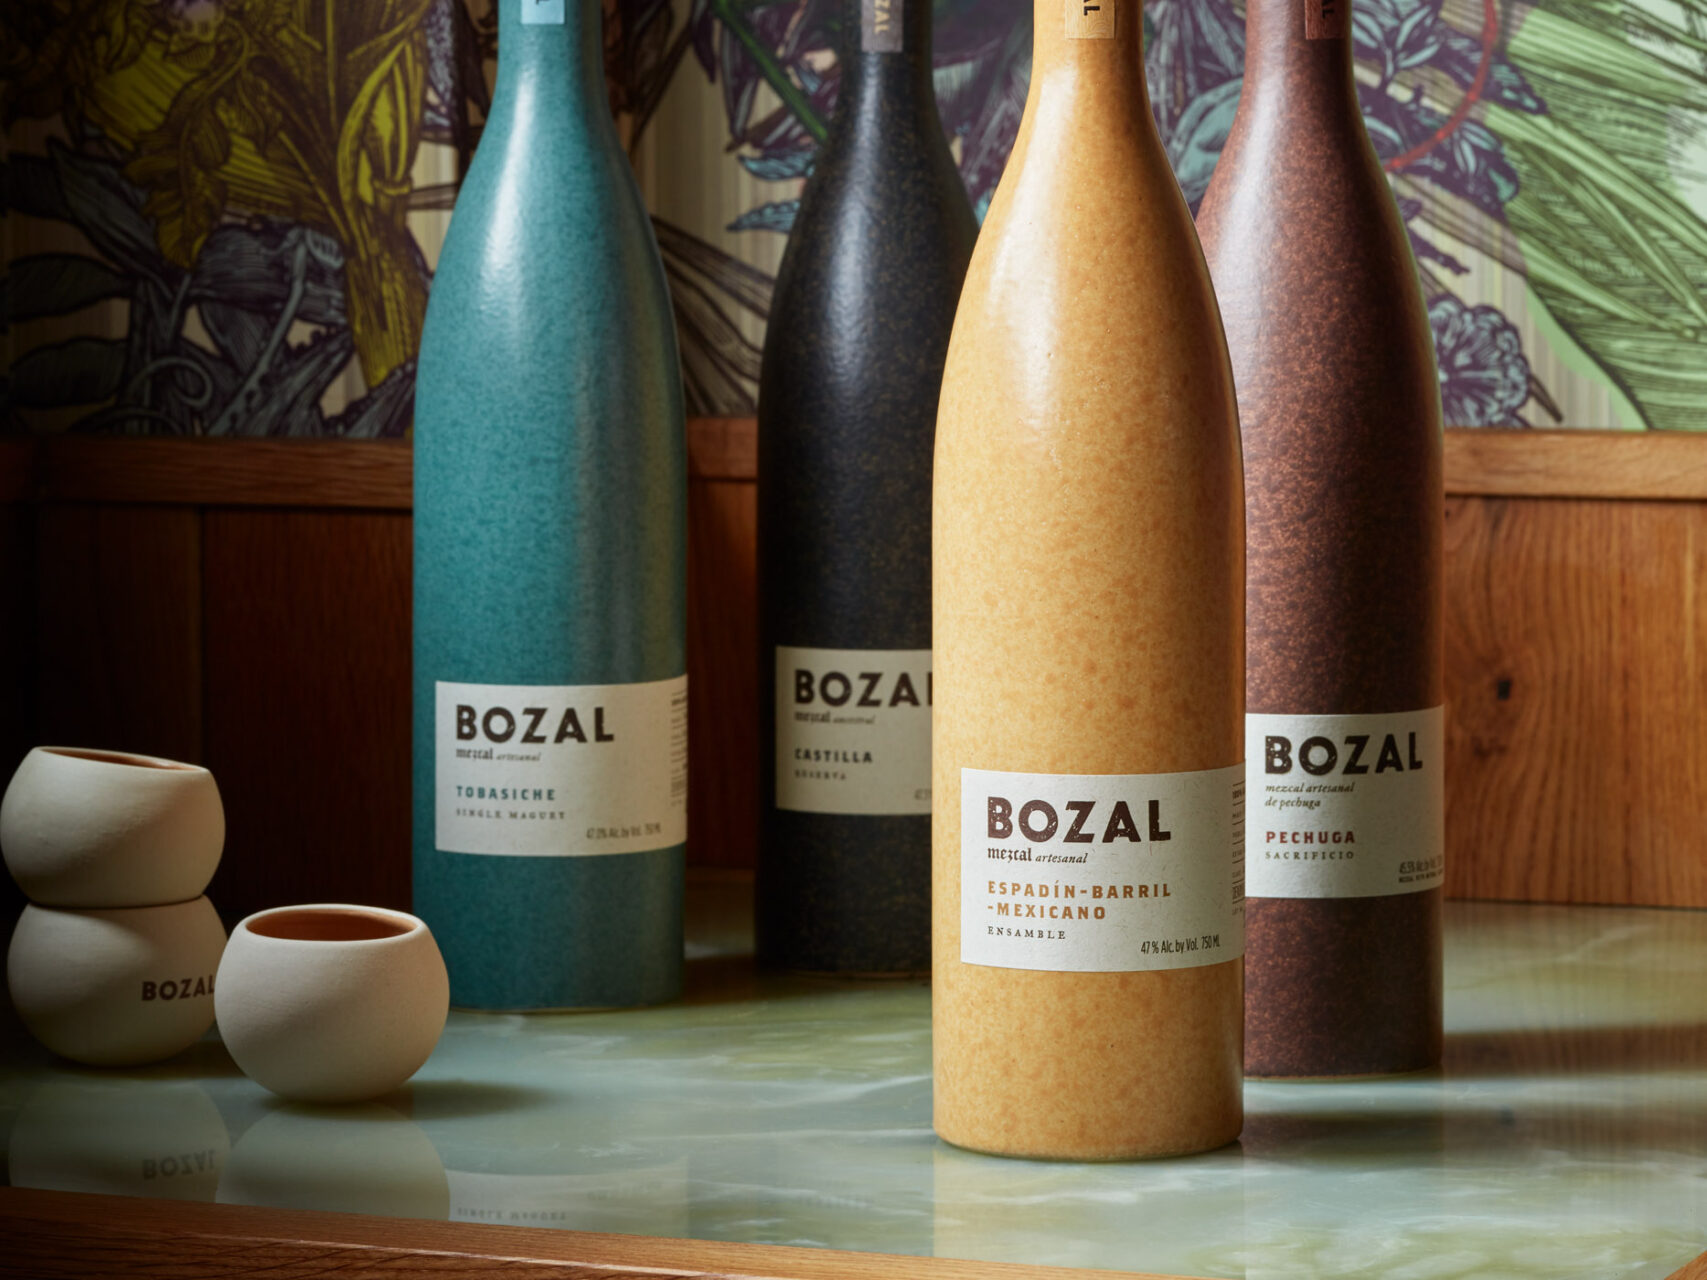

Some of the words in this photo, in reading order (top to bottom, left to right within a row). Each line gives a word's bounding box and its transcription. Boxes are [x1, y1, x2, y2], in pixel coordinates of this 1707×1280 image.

[456, 704, 615, 744] BOZAL
[794, 748, 873, 764] CASTILLA
[1265, 732, 1423, 776] BOZAL
[456, 785, 556, 801] TOBASICHE
[1265, 783, 1304, 793] mezcal
[1306, 782, 1355, 793] artesanal
[1265, 797, 1278, 807] de
[1279, 797, 1321, 810] pechuga
[987, 796, 1171, 843] BOZAL
[1266, 831, 1355, 844] PECHUGA
[987, 847, 1032, 863] mezcal
[1035, 853, 1088, 864] artesanal
[1265, 851, 1354, 860] SACRIFICIO
[988, 880, 1171, 899] ESPADÍN-BARRIL
[988, 926, 1066, 940] ENSAMBLE
[1175, 939, 1184, 954] by
[1186, 937, 1198, 951] Vol.
